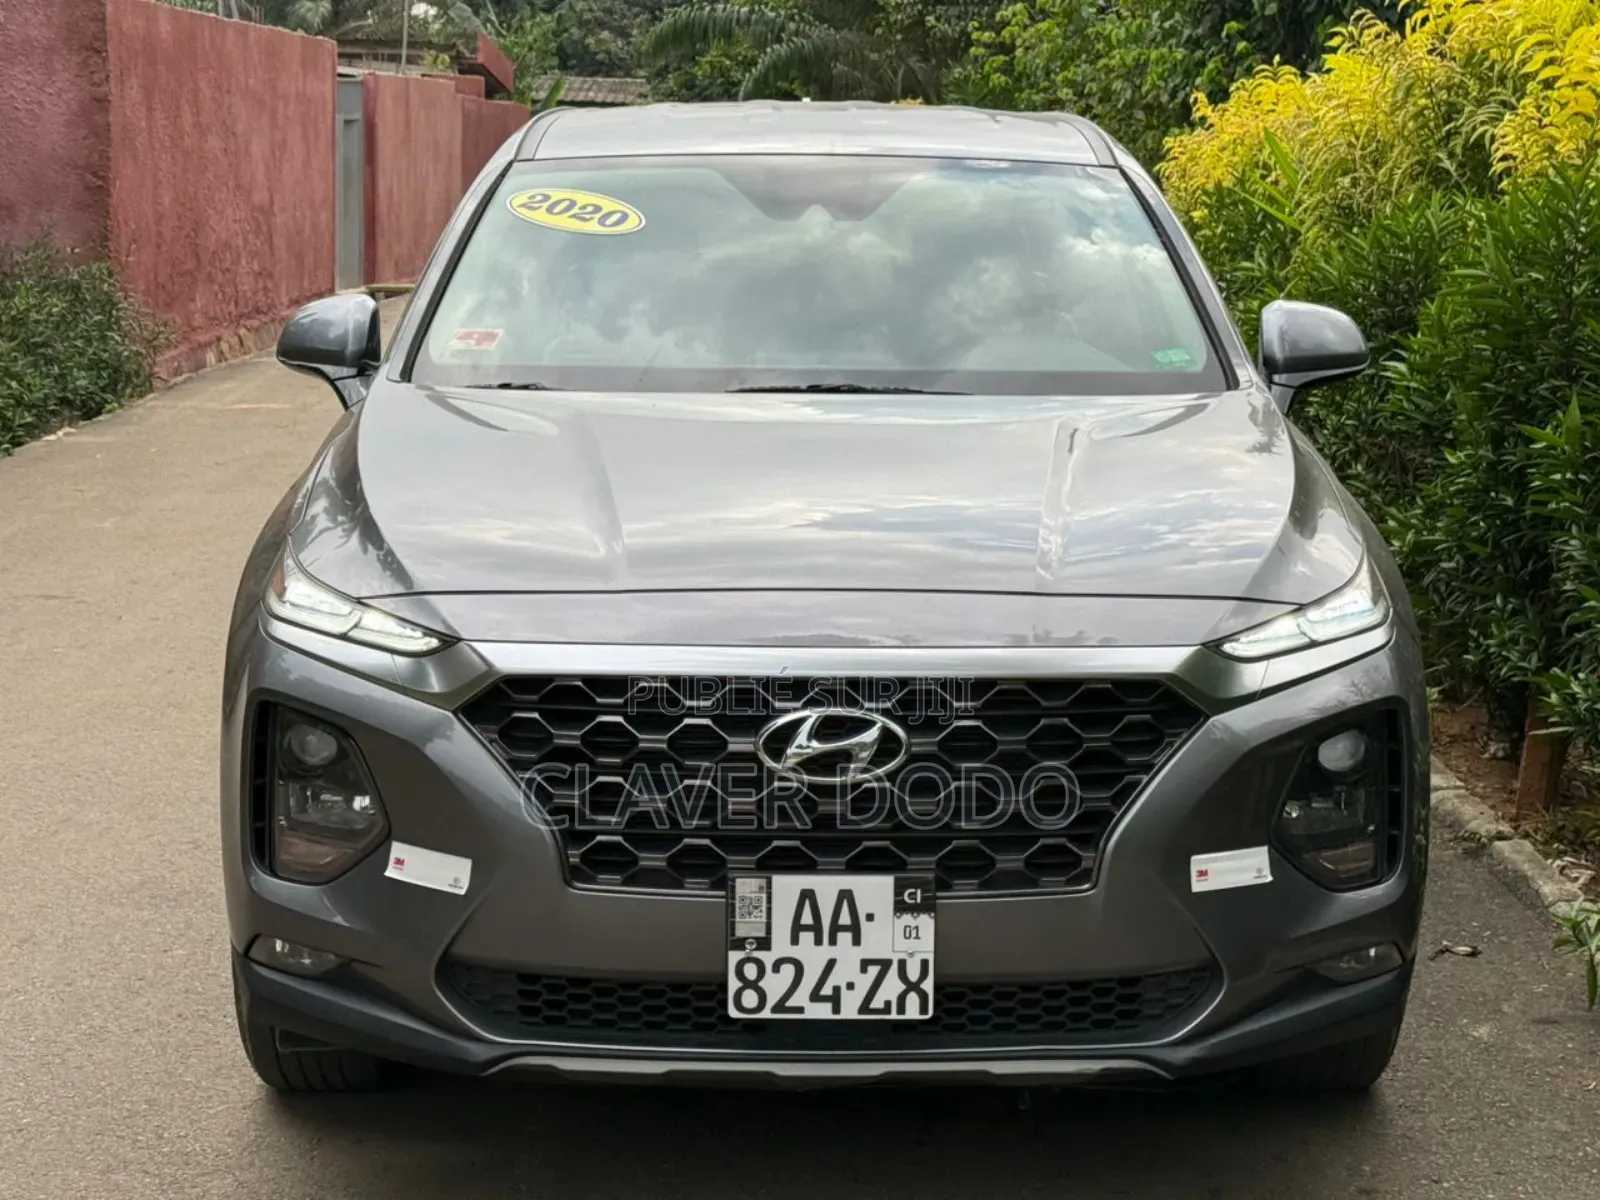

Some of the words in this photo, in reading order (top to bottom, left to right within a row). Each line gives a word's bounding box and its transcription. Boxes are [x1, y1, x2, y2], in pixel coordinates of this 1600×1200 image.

[517, 193, 630, 228] 2020
[1195, 868, 1209, 878] 3M
[903, 888, 922, 905] CI
[903, 924, 922, 941] 01
